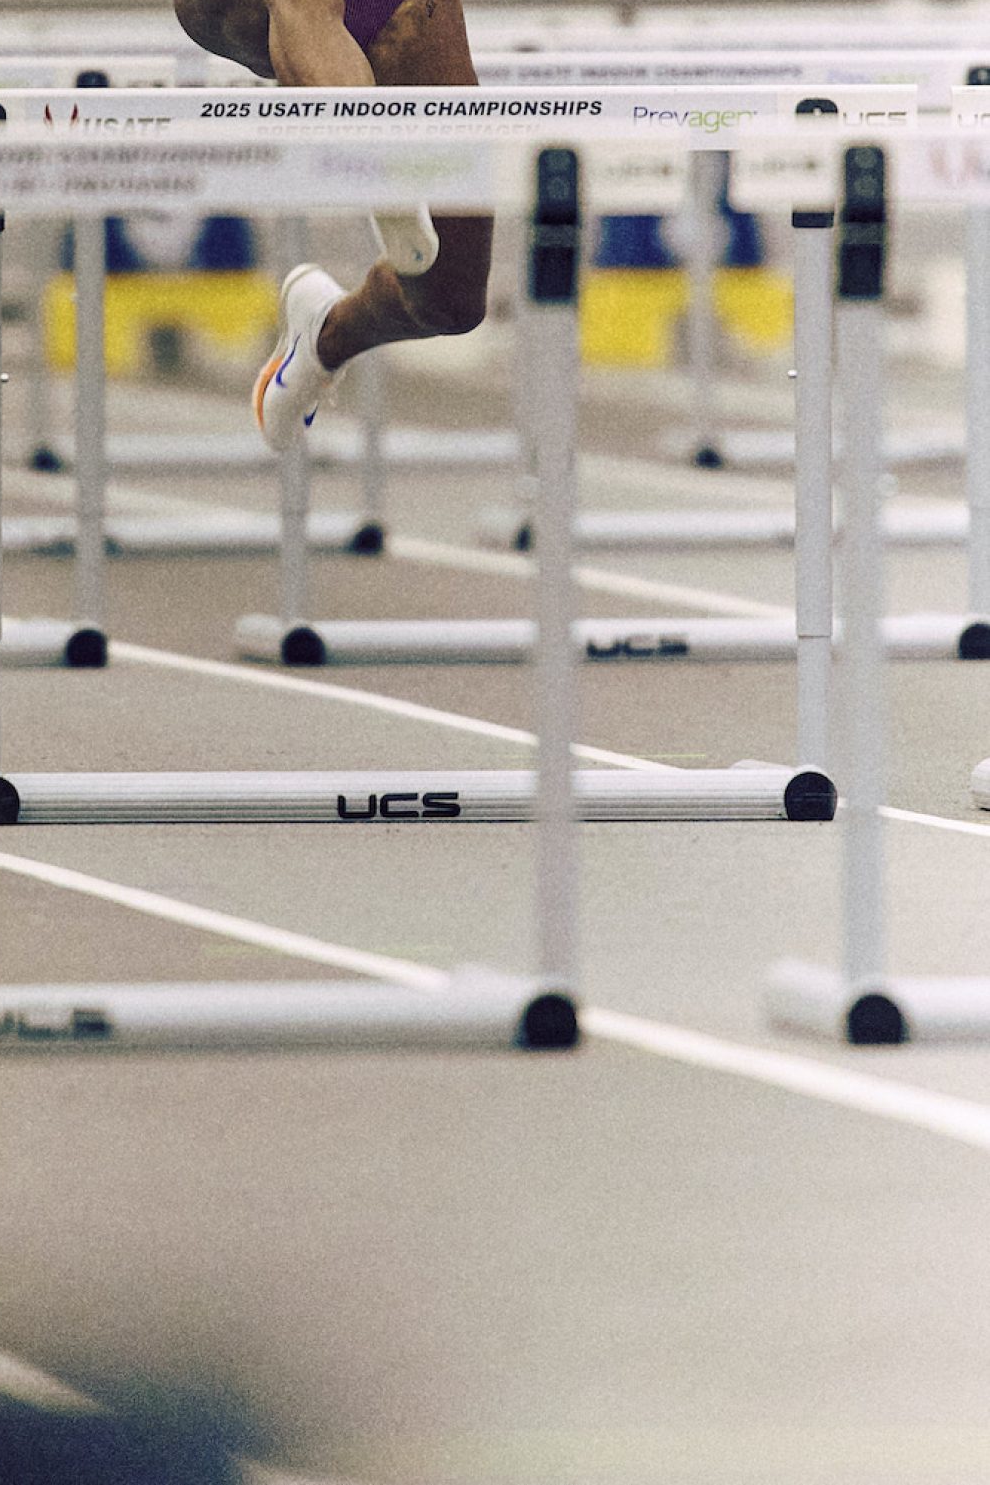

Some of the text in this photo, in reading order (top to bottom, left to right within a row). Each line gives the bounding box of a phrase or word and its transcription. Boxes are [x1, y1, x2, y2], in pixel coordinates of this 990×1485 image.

[200, 100, 602, 117] 2025 USATF INDOOR CHAMPIONSHIPS
[633, 106, 753, 133] Prevagen
[337, 792, 461, 819] UCS
